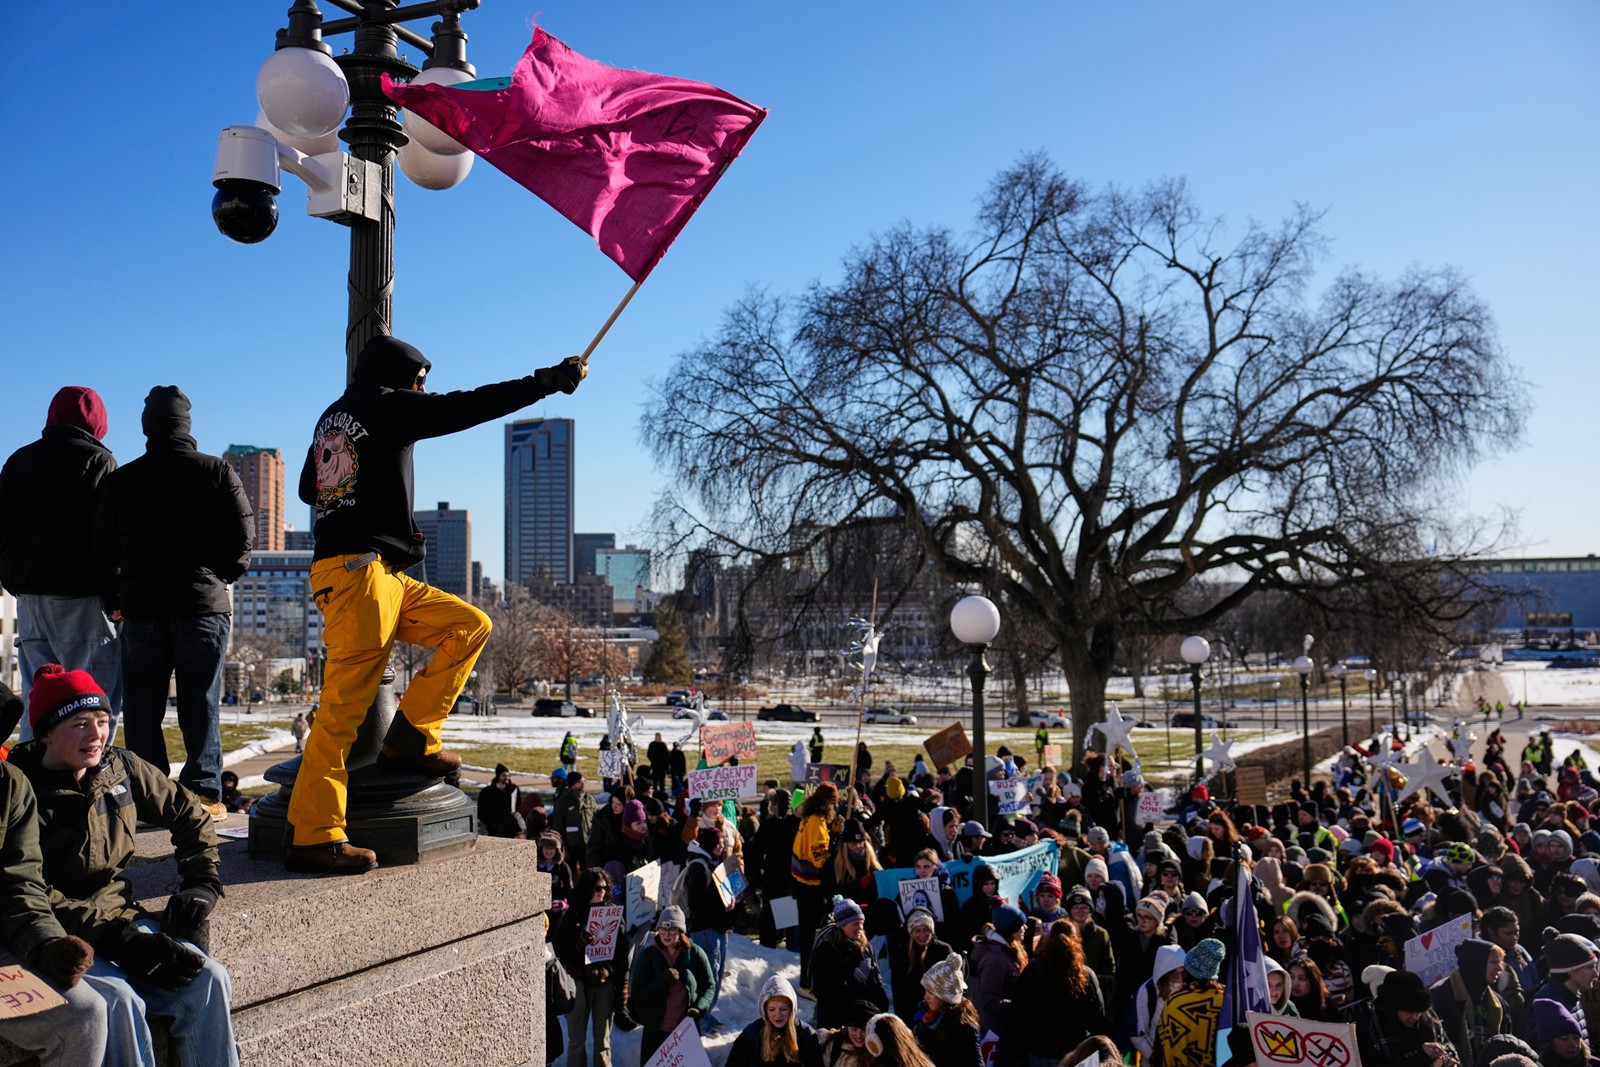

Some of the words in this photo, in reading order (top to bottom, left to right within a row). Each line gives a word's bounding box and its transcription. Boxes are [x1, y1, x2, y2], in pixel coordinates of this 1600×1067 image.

[333, 411, 369, 442] COAST
[58, 696, 100, 717] KIDAROD
[704, 725, 751, 744] Community
[689, 769, 713, 781] ICE
[714, 766, 755, 779] AGENTS
[833, 768, 848, 781] MY
[691, 780, 710, 795] ARE
[712, 778, 748, 789] STINKY
[701, 787, 740, 801] LOSERS!
[901, 880, 938, 896] JUSTICE
[591, 909, 604, 918] WE
[606, 908, 621, 917] ARE
[587, 946, 613, 958] FAMILY
